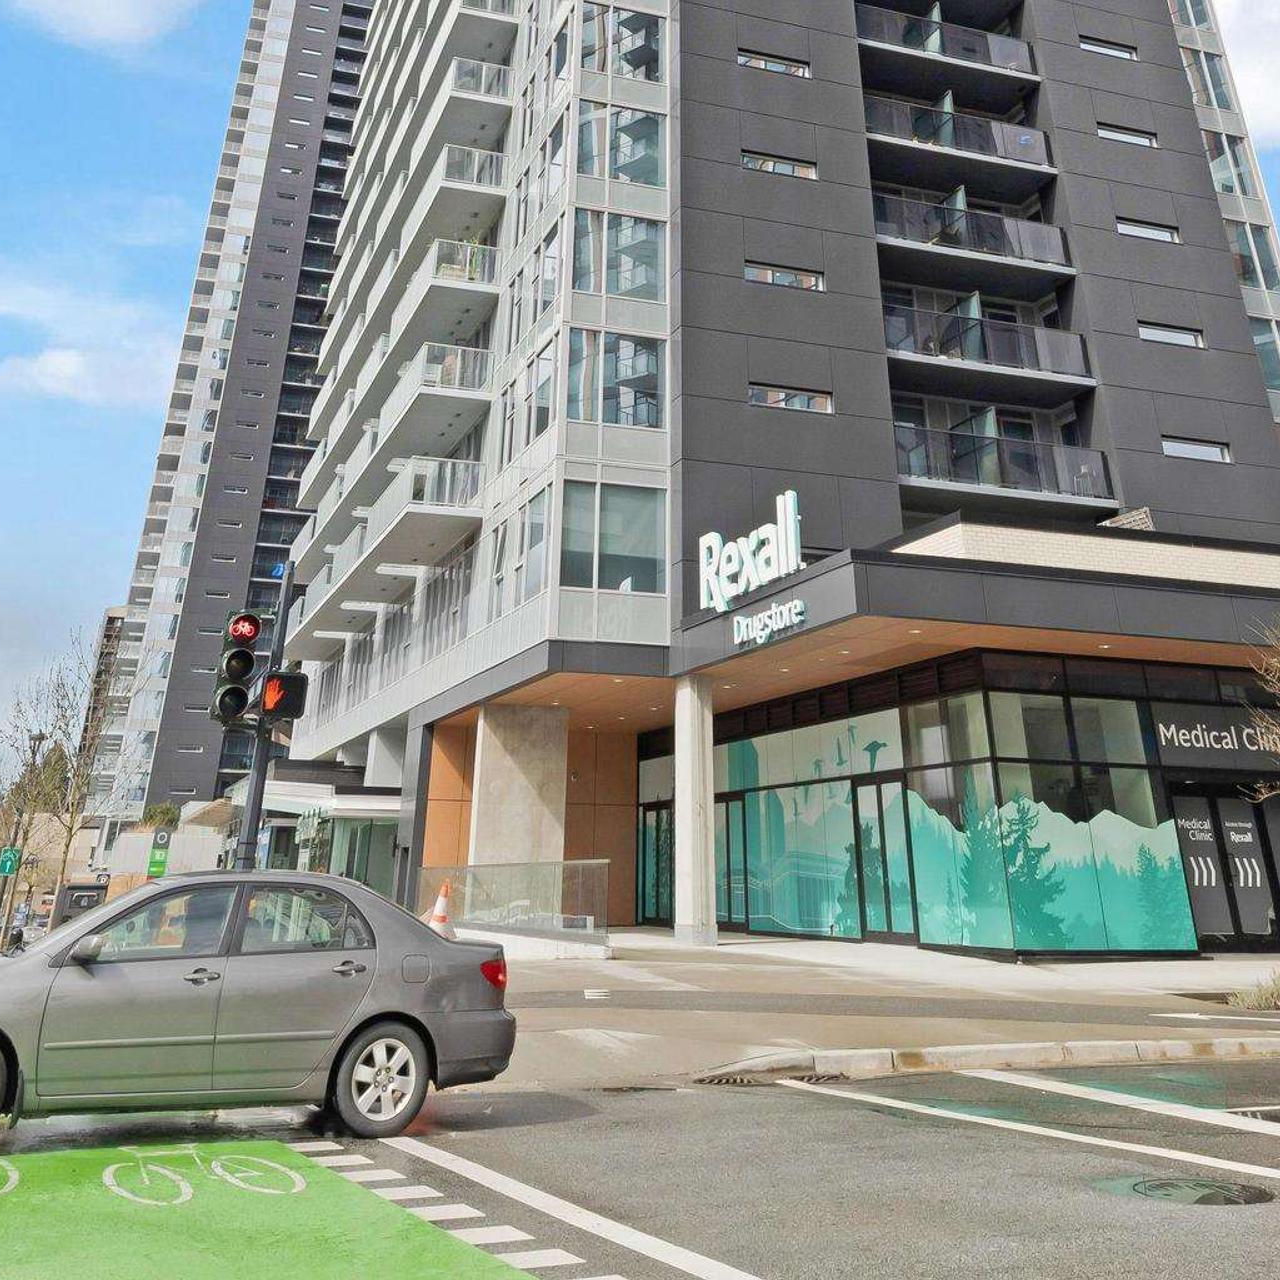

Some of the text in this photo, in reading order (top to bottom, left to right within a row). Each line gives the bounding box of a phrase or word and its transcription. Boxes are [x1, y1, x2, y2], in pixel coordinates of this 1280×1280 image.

[699, 489, 802, 613] Rexall
[733, 599, 806, 645] Drugstore
[1158, 723, 1238, 750] Medical
[1177, 818, 1211, 830] Medical
[1189, 830, 1214, 841] Clinic
